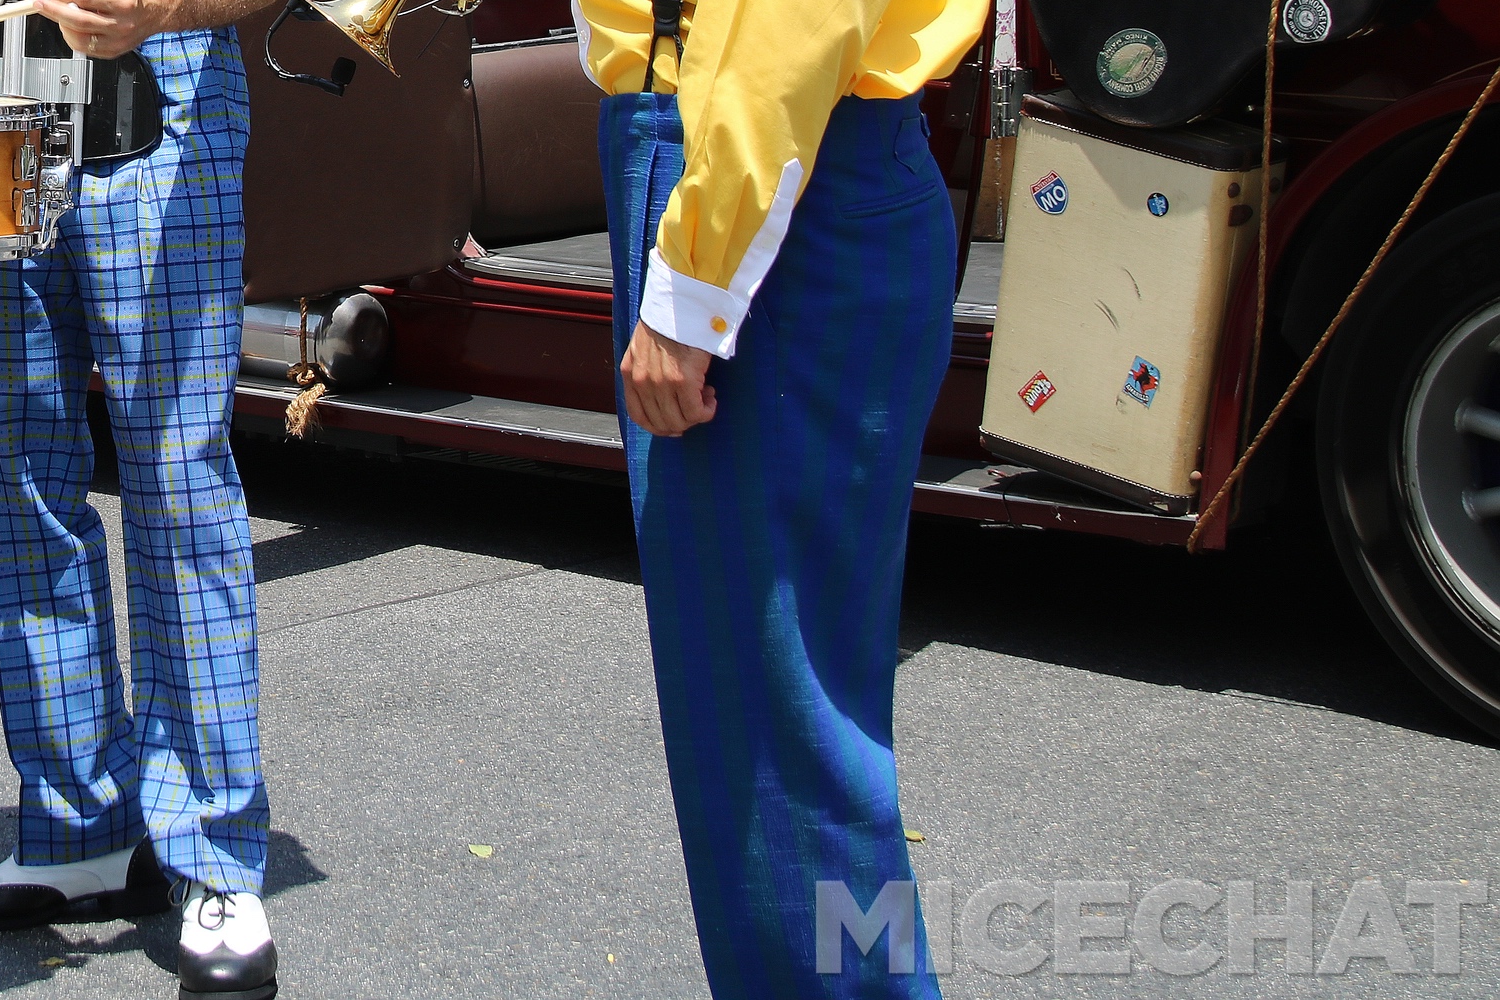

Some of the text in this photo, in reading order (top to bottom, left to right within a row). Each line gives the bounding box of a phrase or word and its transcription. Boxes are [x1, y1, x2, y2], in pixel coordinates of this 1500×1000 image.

[1106, 56, 1164, 93] RICKER HOTEL COMPANY
[1040, 185, 1066, 211] MO
